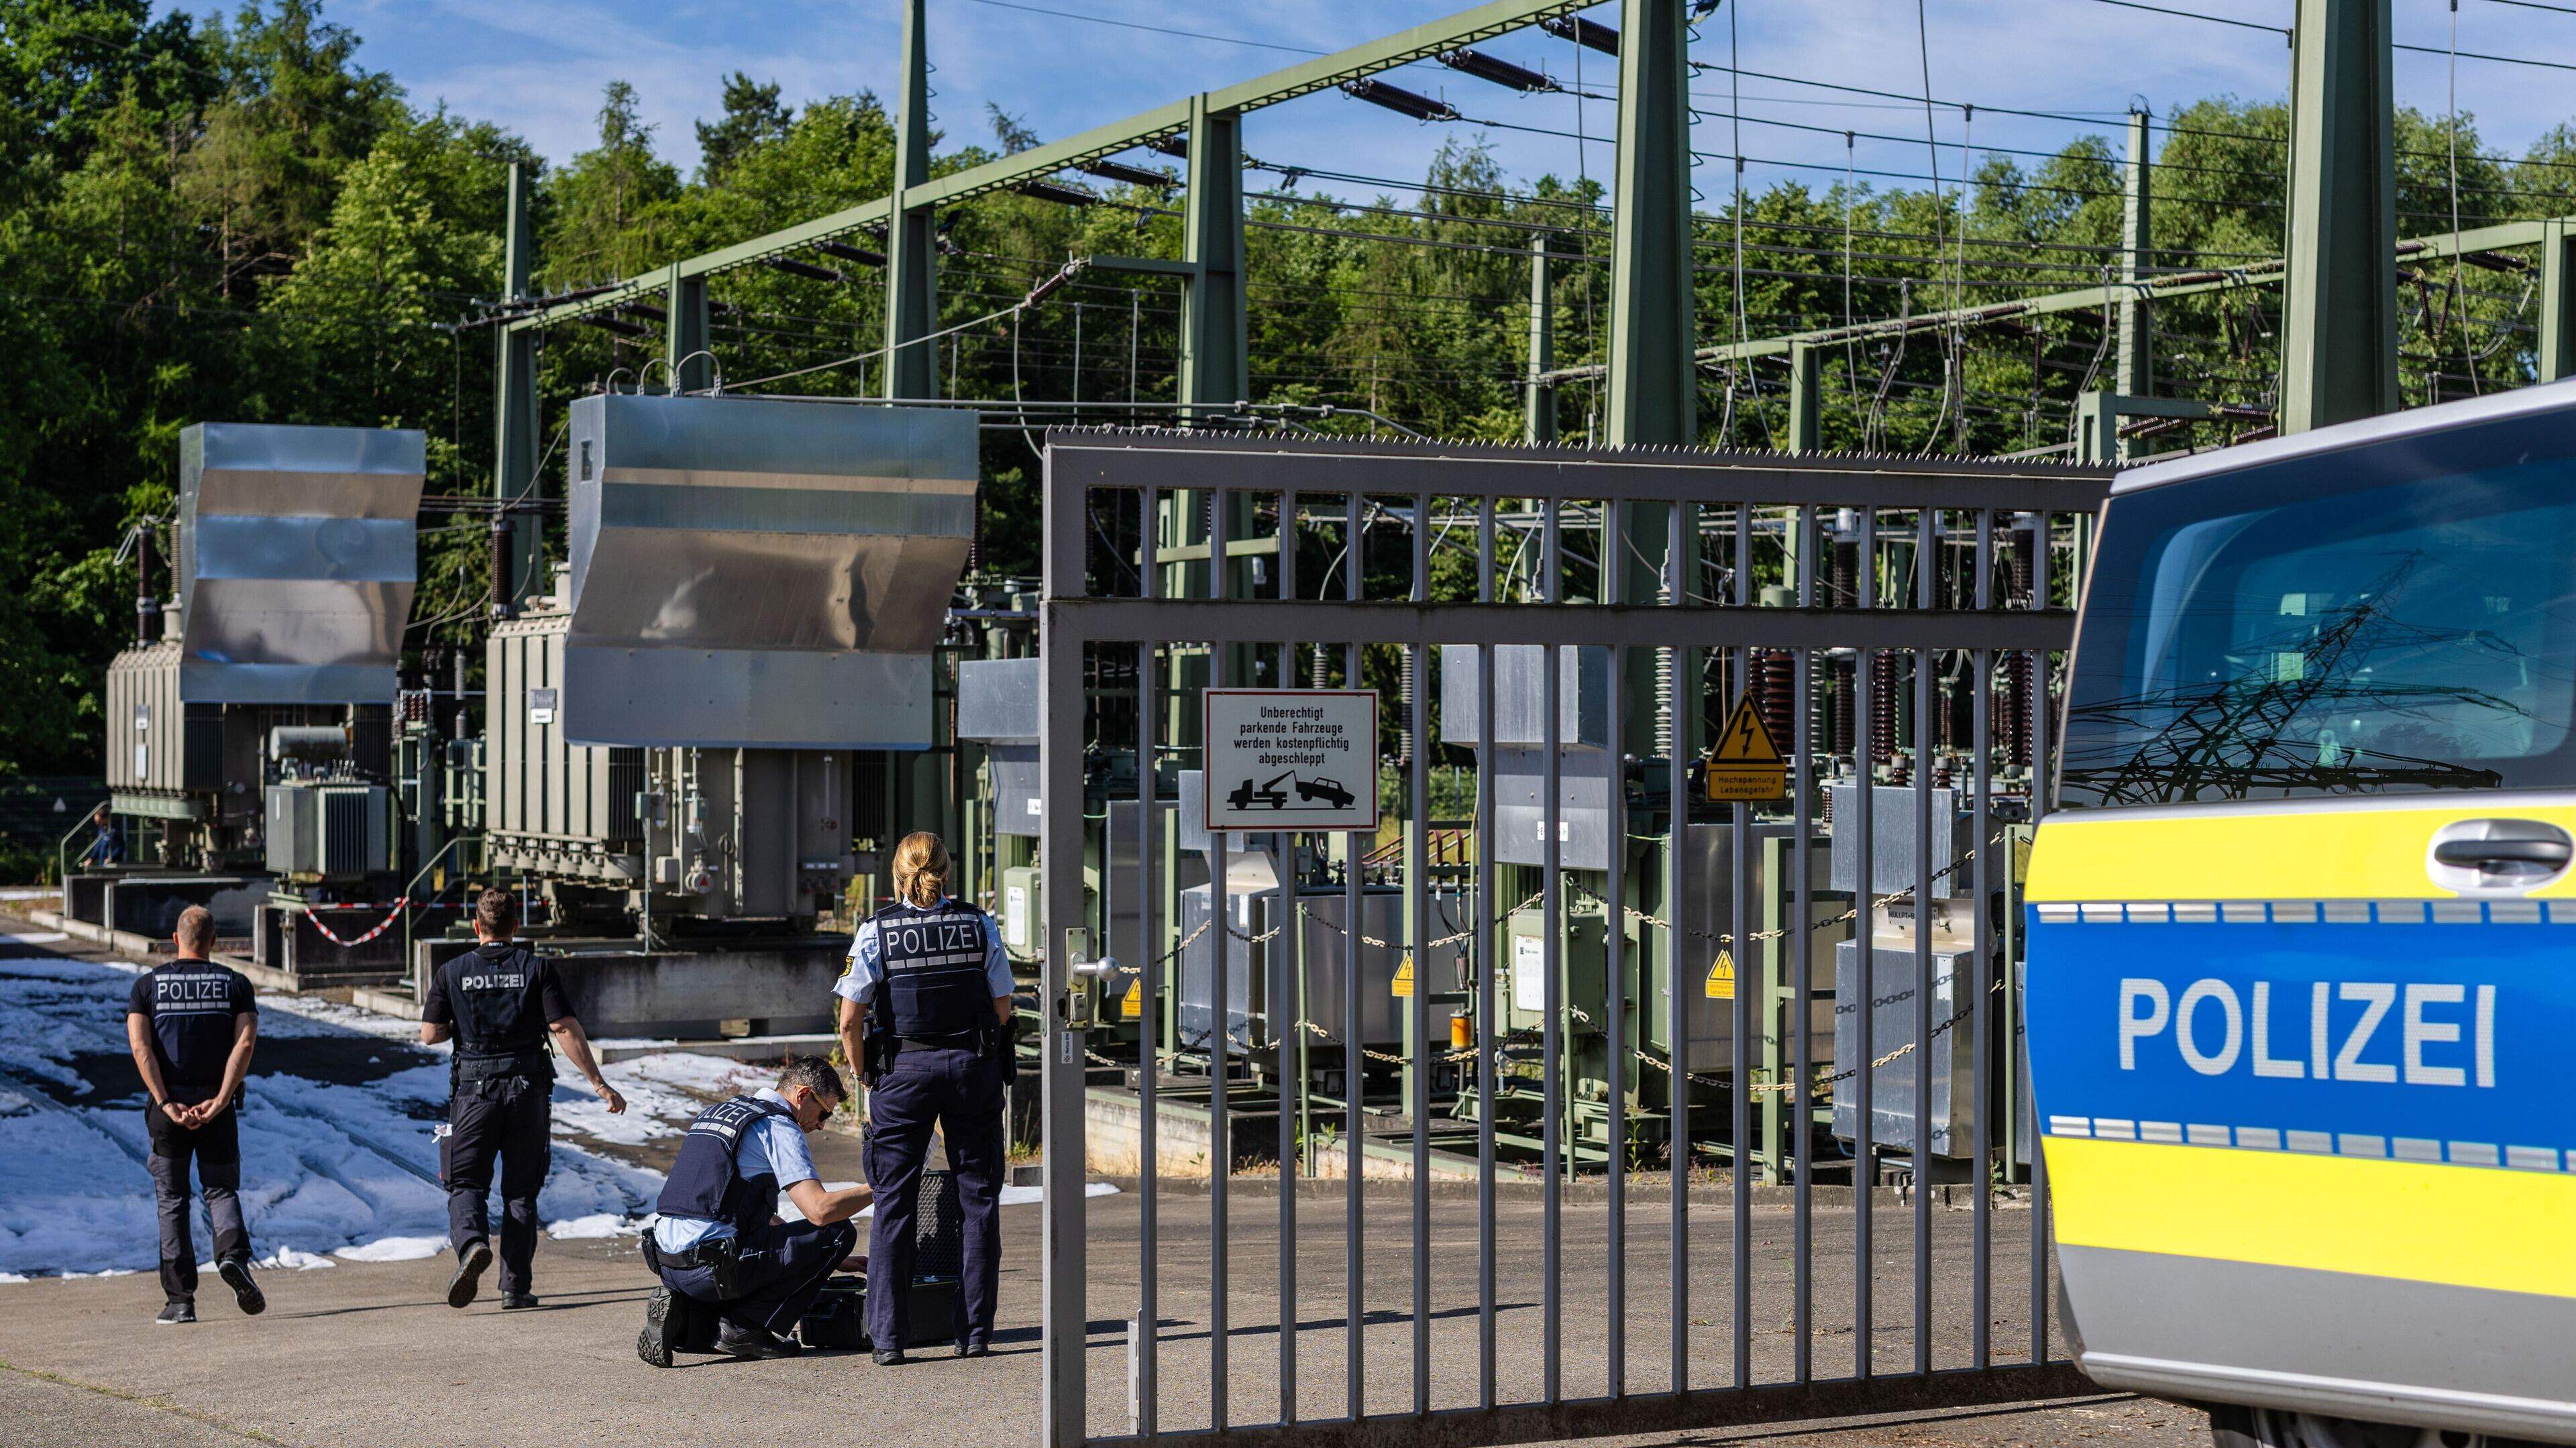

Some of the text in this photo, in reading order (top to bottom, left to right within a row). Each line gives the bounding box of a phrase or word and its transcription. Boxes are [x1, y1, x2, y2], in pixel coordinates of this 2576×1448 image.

[1260, 706, 1324, 721] Unberechtigt
[1240, 722, 1343, 736] parkende Fahrzeuge
[1234, 737, 1349, 751] werden kostenpflichtig
[1258, 752, 1325, 767] abgeschleppt
[1718, 776, 1776, 784] Hochspannung
[1720, 786, 1774, 795] Lebensgefahr
[886, 924, 981, 956] POLIZEI
[462, 974, 525, 991] POLIZEI
[158, 981, 228, 1000] POLIZEI
[2118, 977, 2496, 1088] POLIZEI
[698, 1102, 753, 1125] OLIZEI
